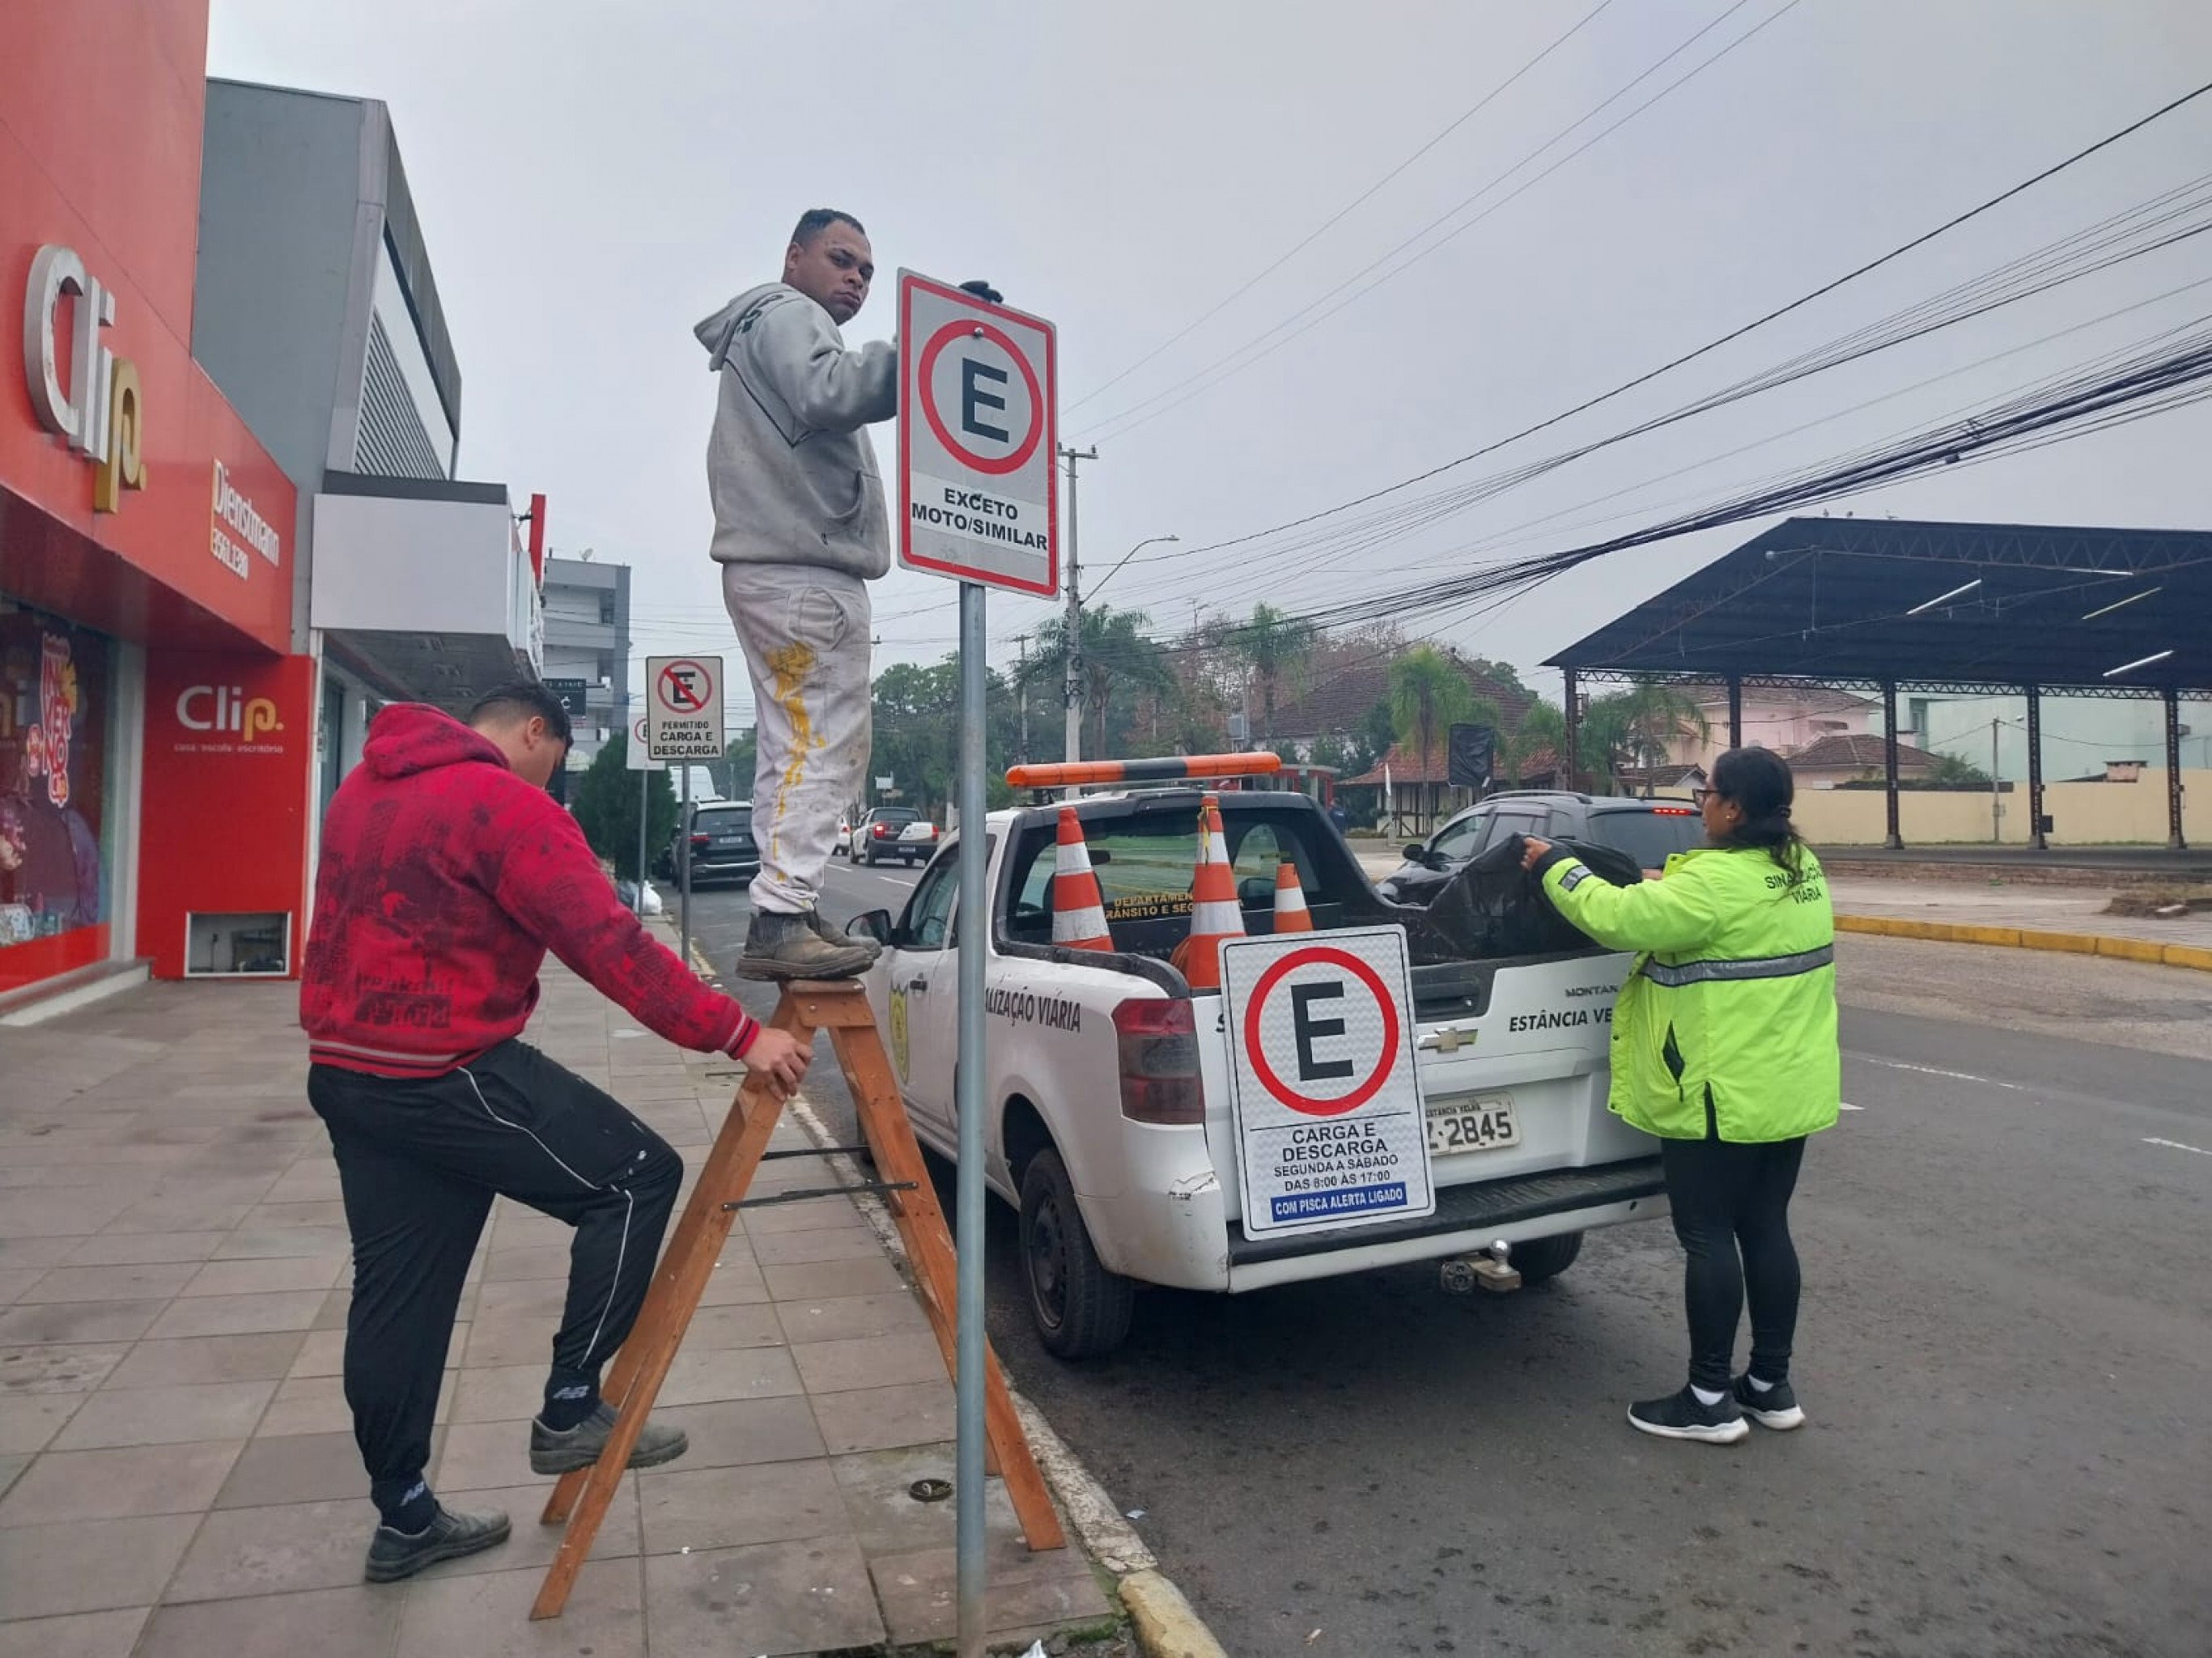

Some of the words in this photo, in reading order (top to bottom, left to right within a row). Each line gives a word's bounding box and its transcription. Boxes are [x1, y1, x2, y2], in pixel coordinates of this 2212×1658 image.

[962, 357, 1009, 444] E
[214, 458, 280, 567] Dienstmann
[944, 487, 1019, 521] EXCETO
[912, 502, 1048, 552] MOTO/SIMILAR
[660, 731, 703, 741] CARGA
[706, 731, 713, 741] E
[662, 720, 708, 730] PERMITIDO
[653, 745, 719, 755] DESCARGA
[1291, 981, 1354, 1082] E
[1509, 1009, 1588, 1032] ESTÂNCIA
[1292, 1124, 1360, 1144] CARGA
[1364, 1122, 1376, 1137] E
[1282, 1138, 1389, 1163] DESCARGA
[1274, 1161, 1335, 1178] SEGUNDA
[1335, 1161, 1344, 1171] A
[1284, 1179, 1310, 1192] DAS
[1313, 1175, 1338, 1189] 8:00
[1340, 1172, 1356, 1185] ÀS
[1361, 1170, 1390, 1183] 17:00
[1276, 1201, 1297, 1215] COM
[1300, 1197, 1329, 1212] PISCA
[1331, 1193, 1366, 1207] ALERTA
[1368, 1188, 1403, 1202] LIGADO
